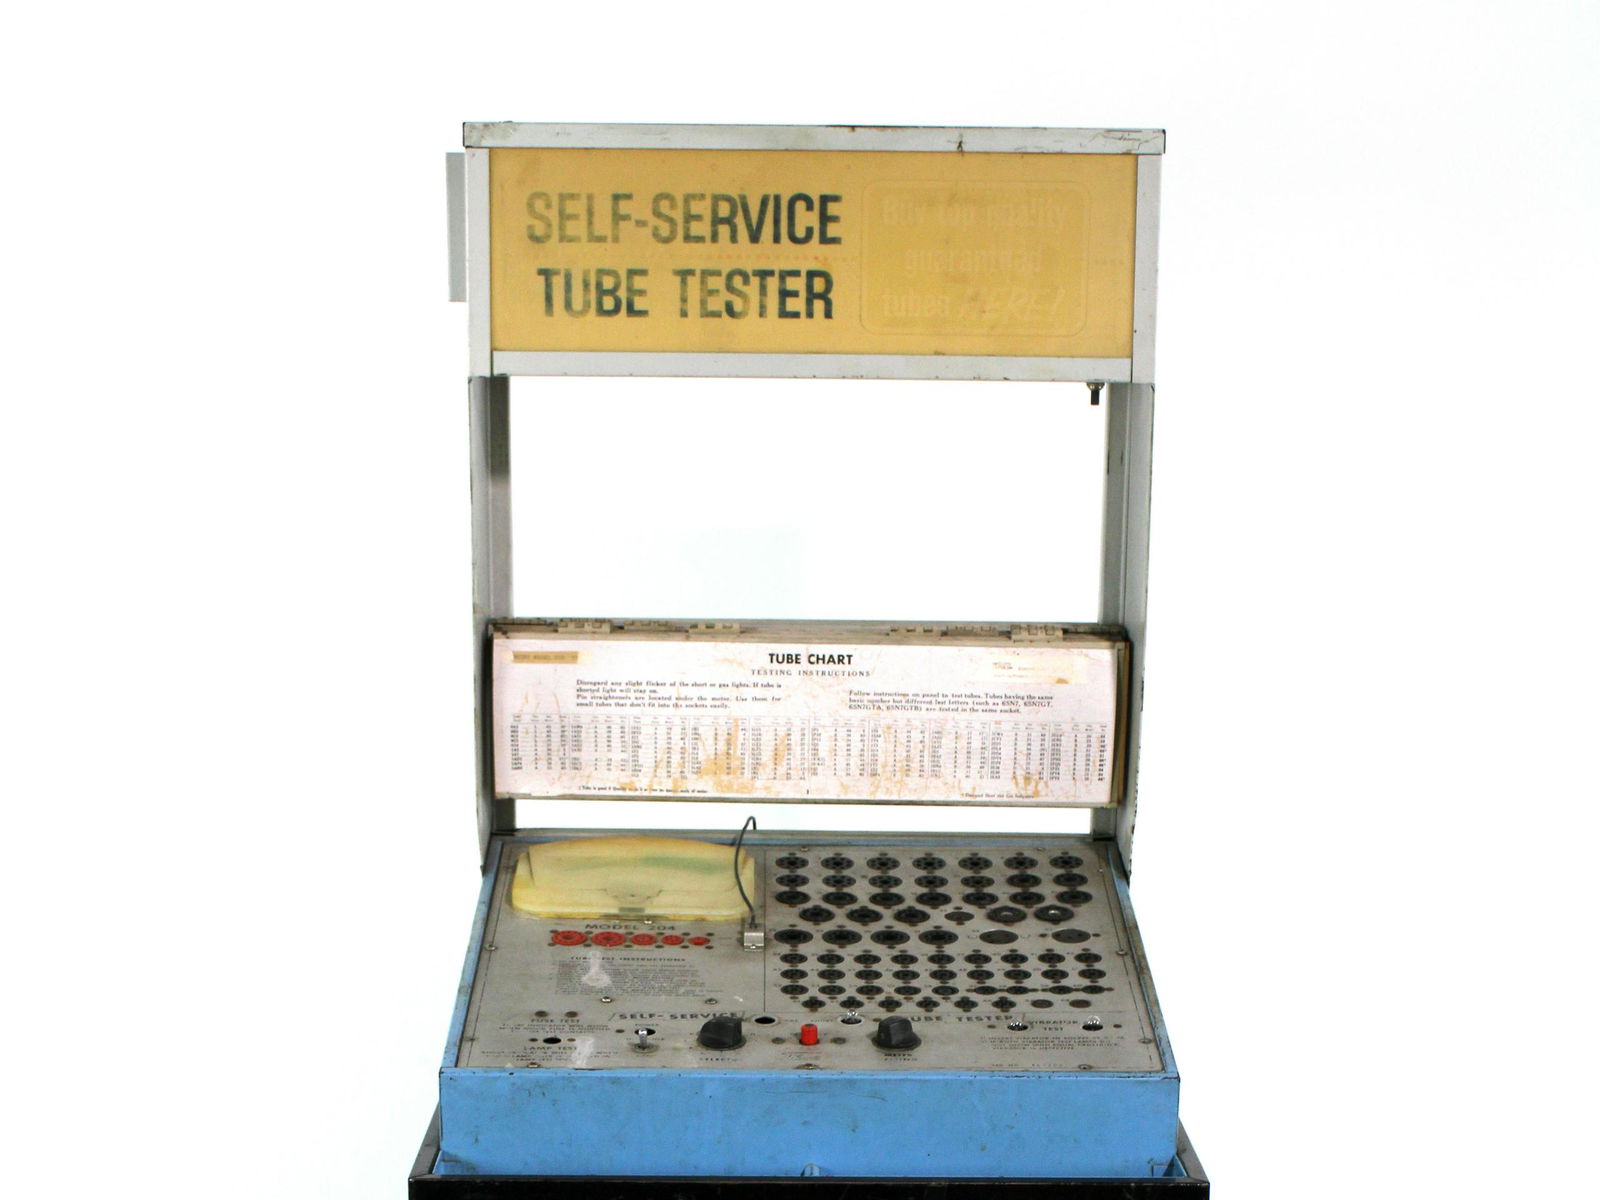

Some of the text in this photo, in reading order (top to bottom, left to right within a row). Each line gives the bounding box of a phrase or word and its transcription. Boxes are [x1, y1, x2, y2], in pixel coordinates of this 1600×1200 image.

[526, 191, 843, 245] SELF-SERVICE
[537, 267, 834, 319] TUBE TESTER
[768, 653, 854, 665] TUBE CHART
